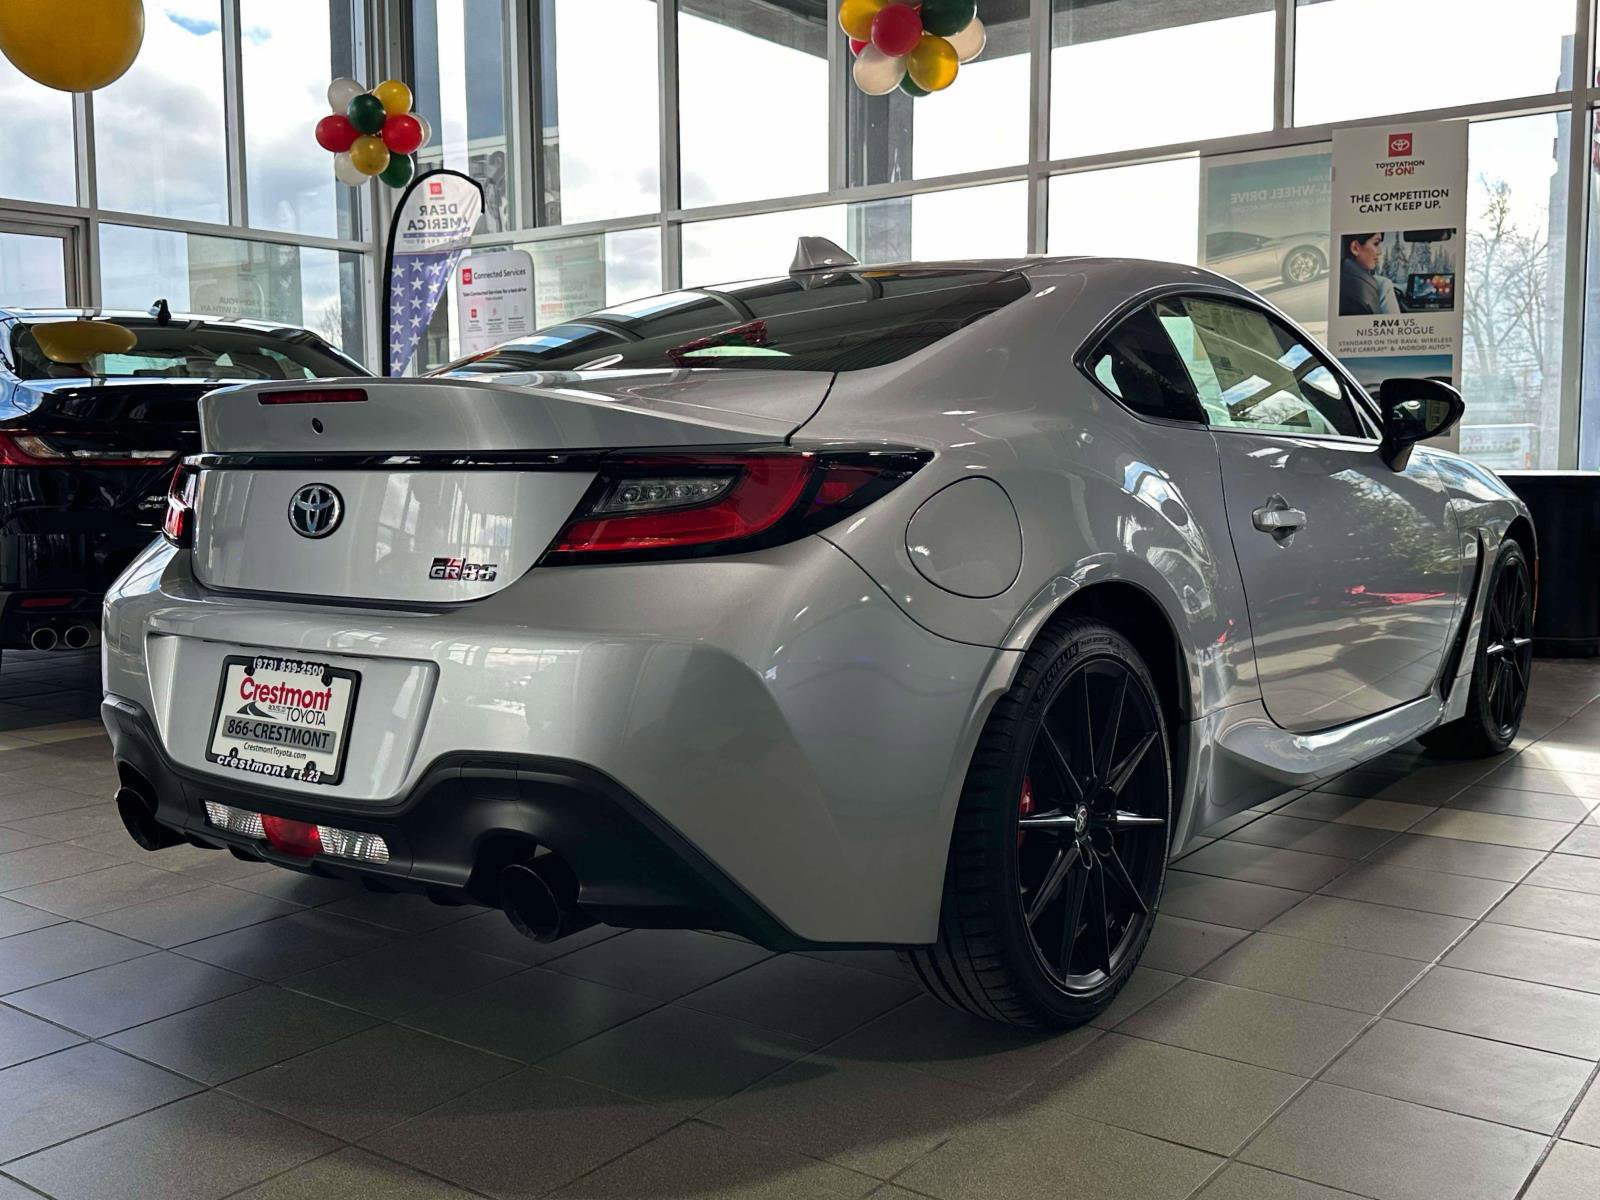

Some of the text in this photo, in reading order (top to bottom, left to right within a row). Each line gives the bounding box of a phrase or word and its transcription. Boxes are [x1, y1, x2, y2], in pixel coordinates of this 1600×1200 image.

[1376, 160, 1424, 169] TOYOTATHON
[1384, 166, 1414, 176] IS ON!
[1350, 189, 1449, 204] THE COMPETITION
[1360, 200, 1442, 214] CAN'T KEEP UP.
[474, 268, 526, 280] Connected Services
[1373, 318, 1418, 328] RAV4 VS.
[1356, 326, 1434, 336] NISSAN ROGUE
[253, 658, 325, 676] (973) 839-2500
[240, 676, 332, 710] Crestmont
[286, 706, 326, 726] TOYOTA
[228, 719, 330, 749] 866-CRESTMONT
[244, 743, 306, 760] CrestmontToyota.com
[217, 755, 320, 782] crestmont rt.23
